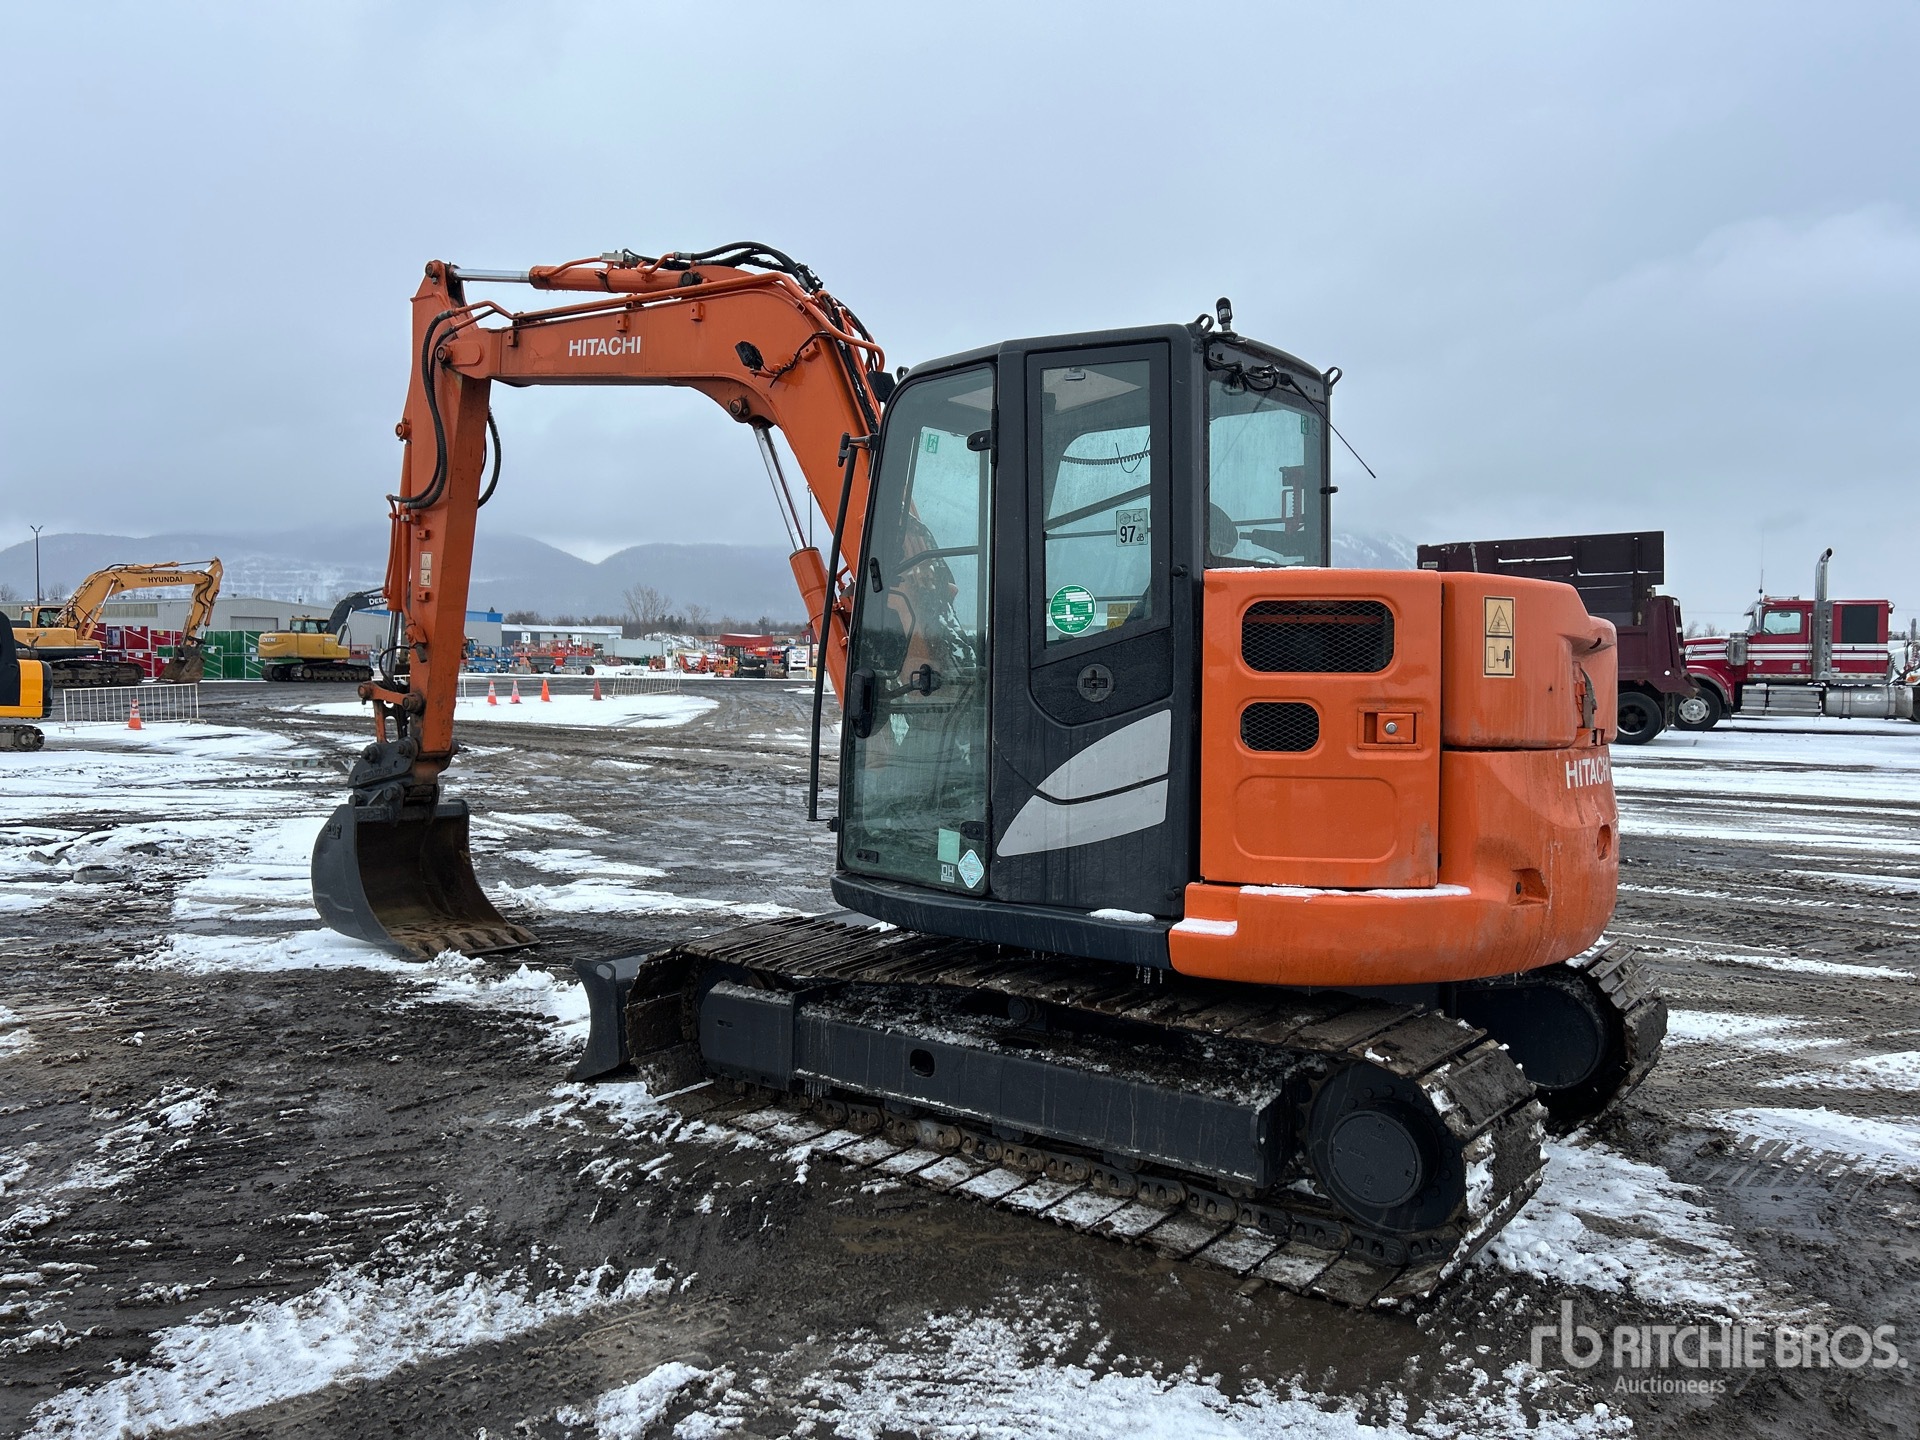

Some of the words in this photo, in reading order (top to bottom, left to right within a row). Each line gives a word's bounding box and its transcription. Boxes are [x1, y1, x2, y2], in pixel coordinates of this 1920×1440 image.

[568, 336, 641, 356] HITACHI
[1120, 525, 1136, 543] 97
[368, 597, 389, 606] DEER
[1565, 756, 1610, 788] HITACH
